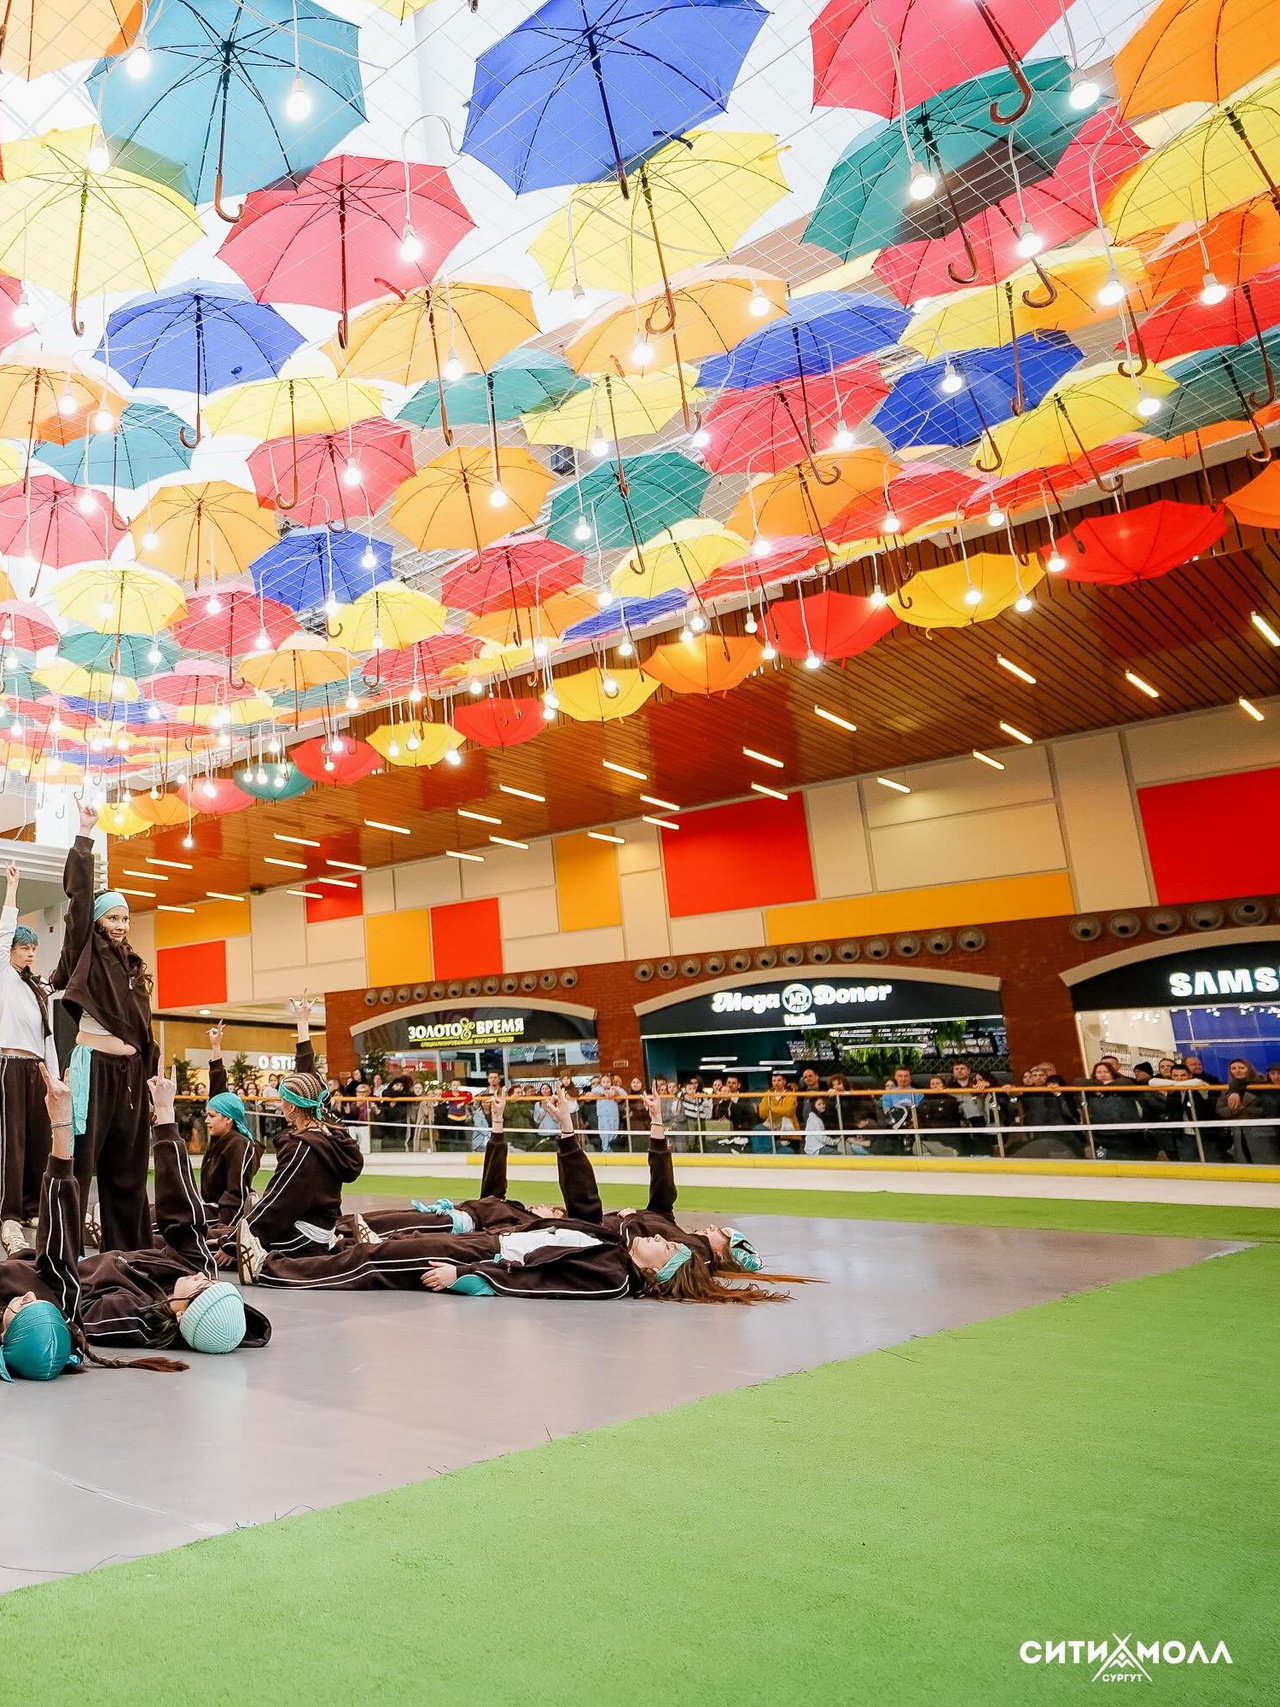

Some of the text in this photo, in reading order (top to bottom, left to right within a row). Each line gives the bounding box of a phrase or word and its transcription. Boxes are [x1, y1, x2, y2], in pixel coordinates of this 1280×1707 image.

[1169, 966, 1280, 998] SAMS
[711, 991, 781, 1015] Mega
[811, 984, 893, 1005] Doner
[407, 1022, 462, 1040] ЗОЛОТО
[475, 1017, 525, 1035] ВРЕМЯ
